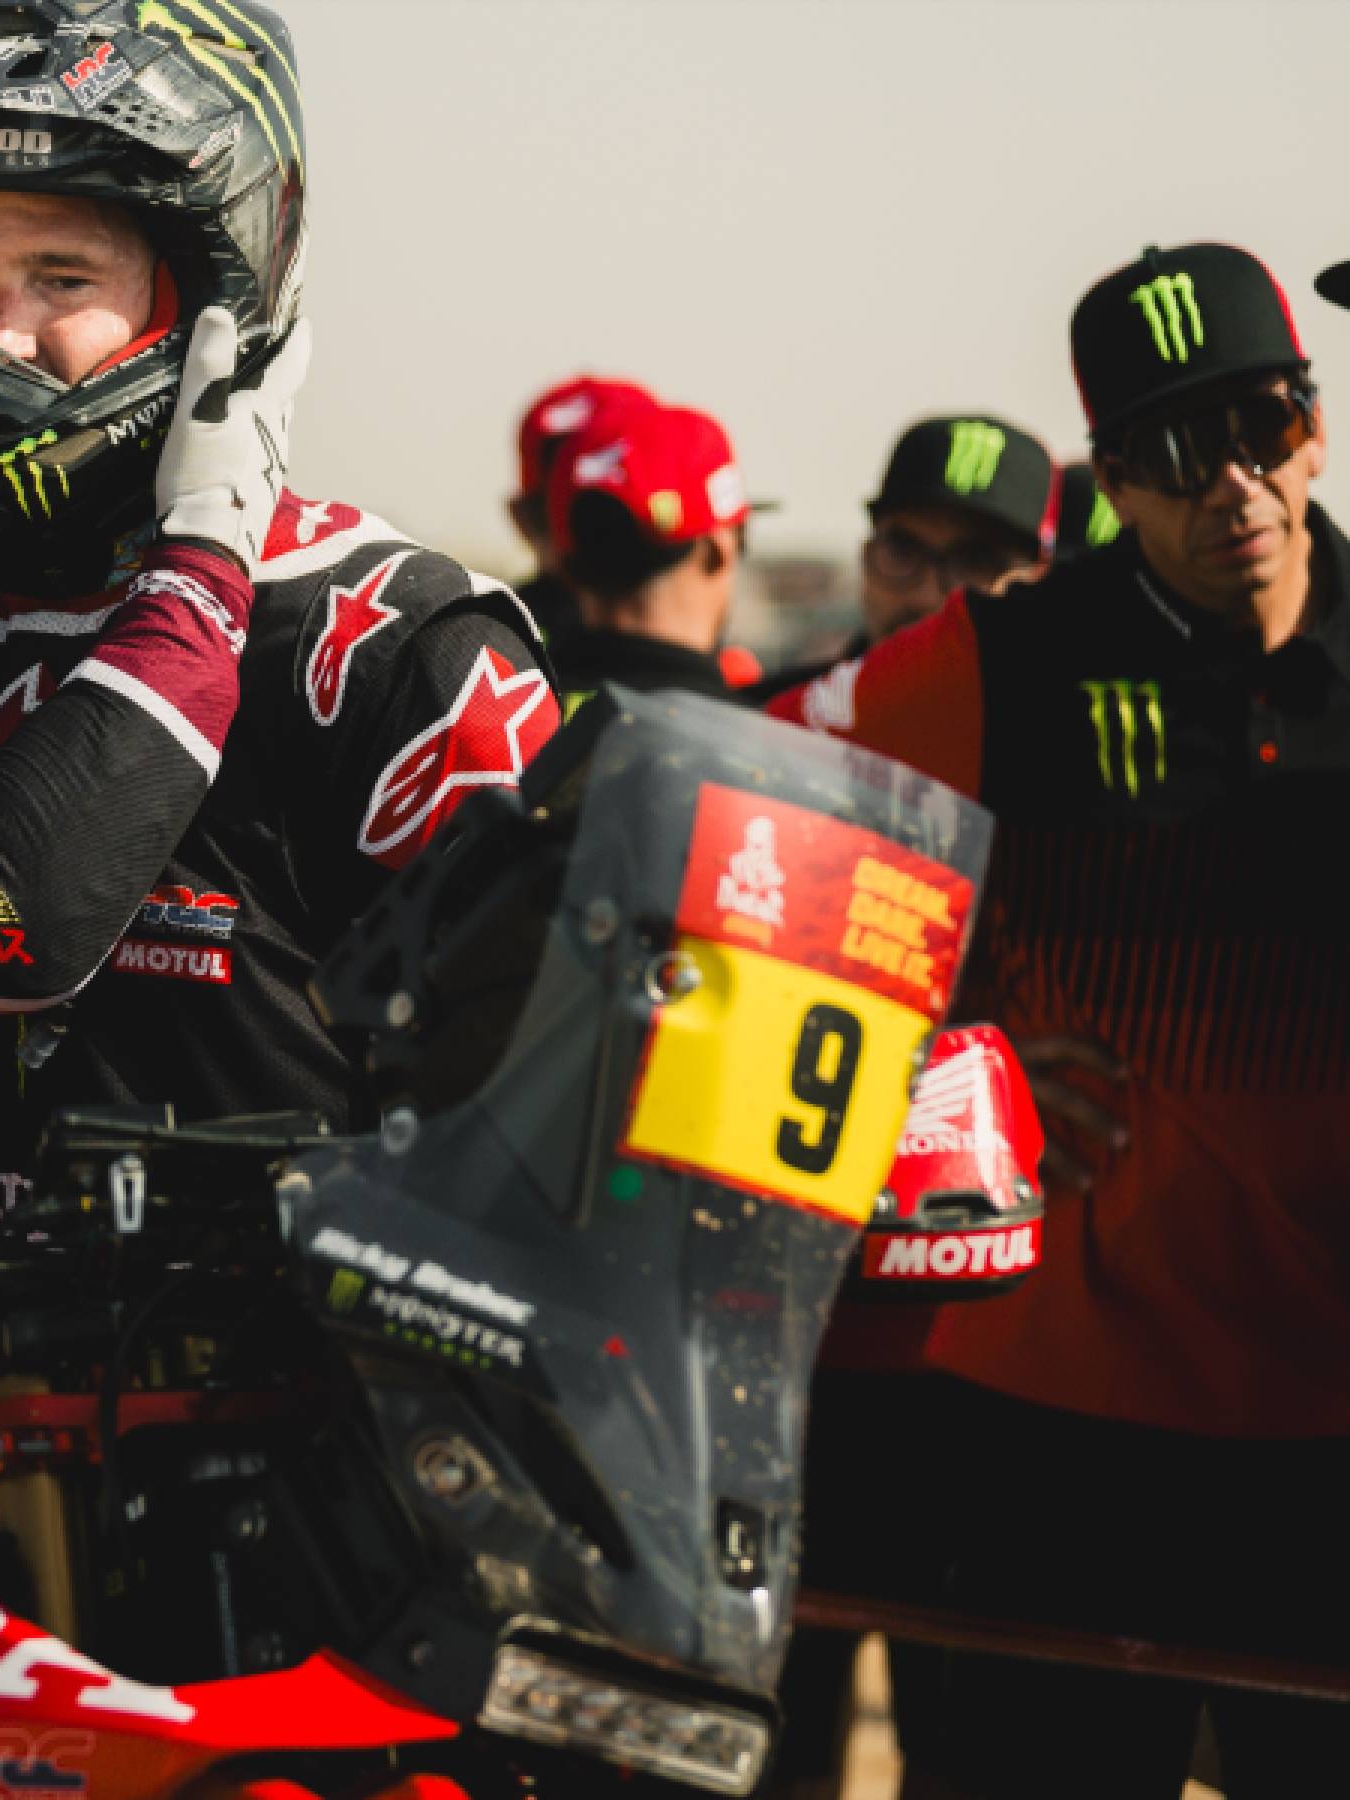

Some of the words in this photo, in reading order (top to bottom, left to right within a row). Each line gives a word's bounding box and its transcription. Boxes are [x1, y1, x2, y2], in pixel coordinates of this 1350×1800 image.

[116, 942, 226, 979] MOTUL
[776, 1002, 863, 1176] 9
[878, 1226, 1036, 1276] MOTUL
